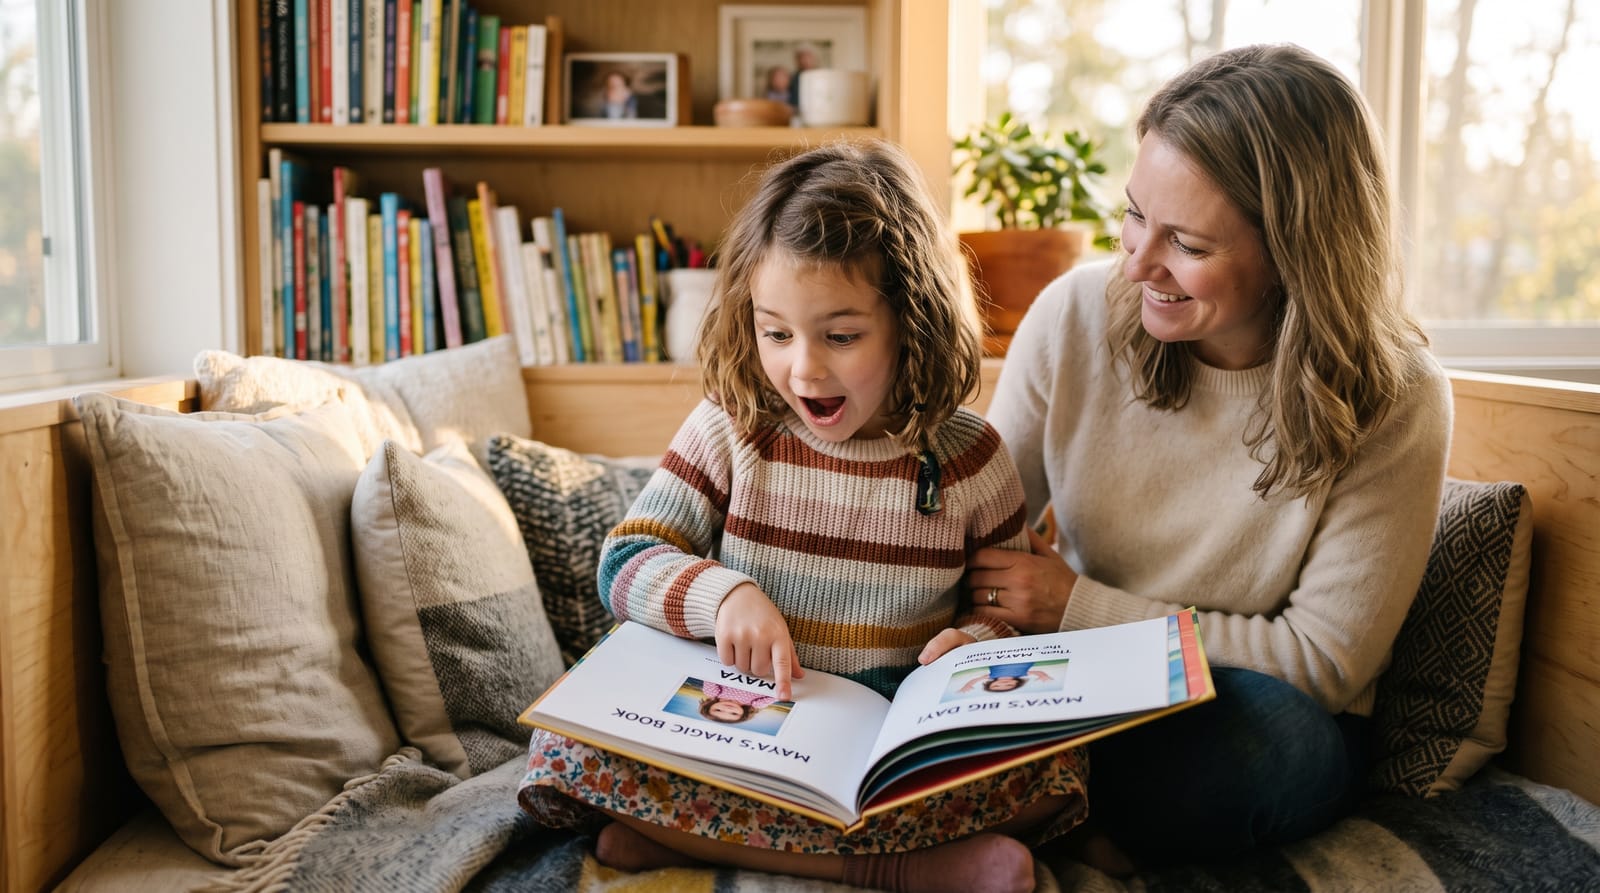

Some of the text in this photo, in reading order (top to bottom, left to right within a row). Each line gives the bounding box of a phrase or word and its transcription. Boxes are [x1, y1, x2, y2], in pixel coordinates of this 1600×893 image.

[997, 652, 1032, 660] MAYA
[720, 669, 776, 690] MAYA
[917, 695, 1083, 724] MAYA'S BIG DAY!
[612, 708, 810, 763] MAYA'S MAGIC BOOK
